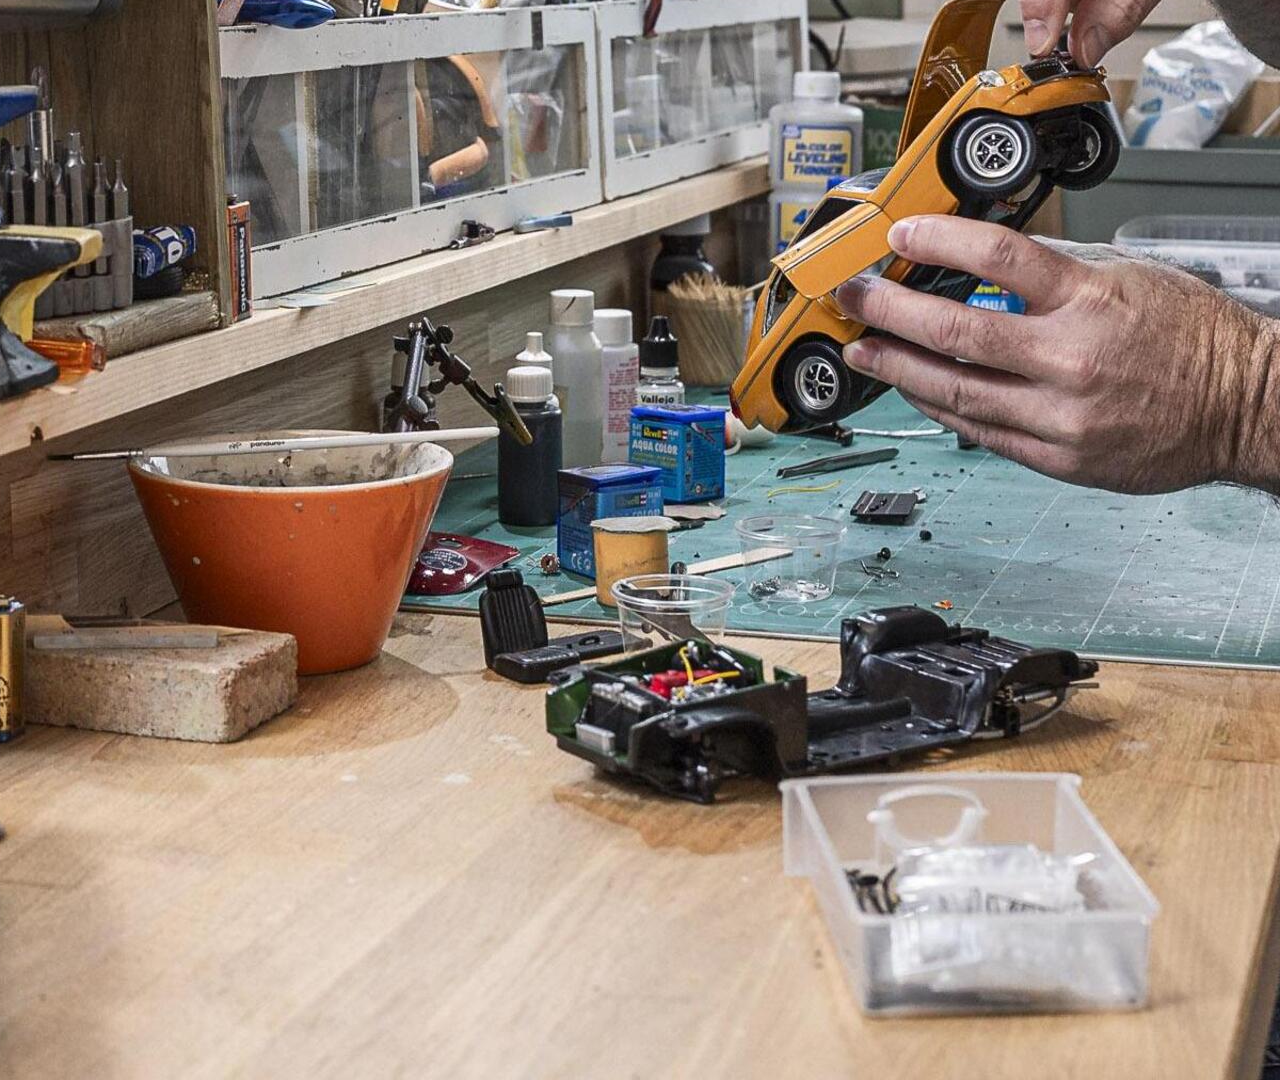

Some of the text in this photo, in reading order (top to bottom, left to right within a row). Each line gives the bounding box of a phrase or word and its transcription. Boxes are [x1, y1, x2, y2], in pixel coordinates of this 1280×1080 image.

[787, 152, 848, 163] LEVELING
[793, 165, 844, 176] THINNER
[239, 226, 248, 313] Panasonic
[972, 299, 1009, 313] AQUA
[640, 394, 675, 405] Vallejo
[643, 426, 663, 439] Revell
[632, 439, 678, 456] AQUA COLOR
